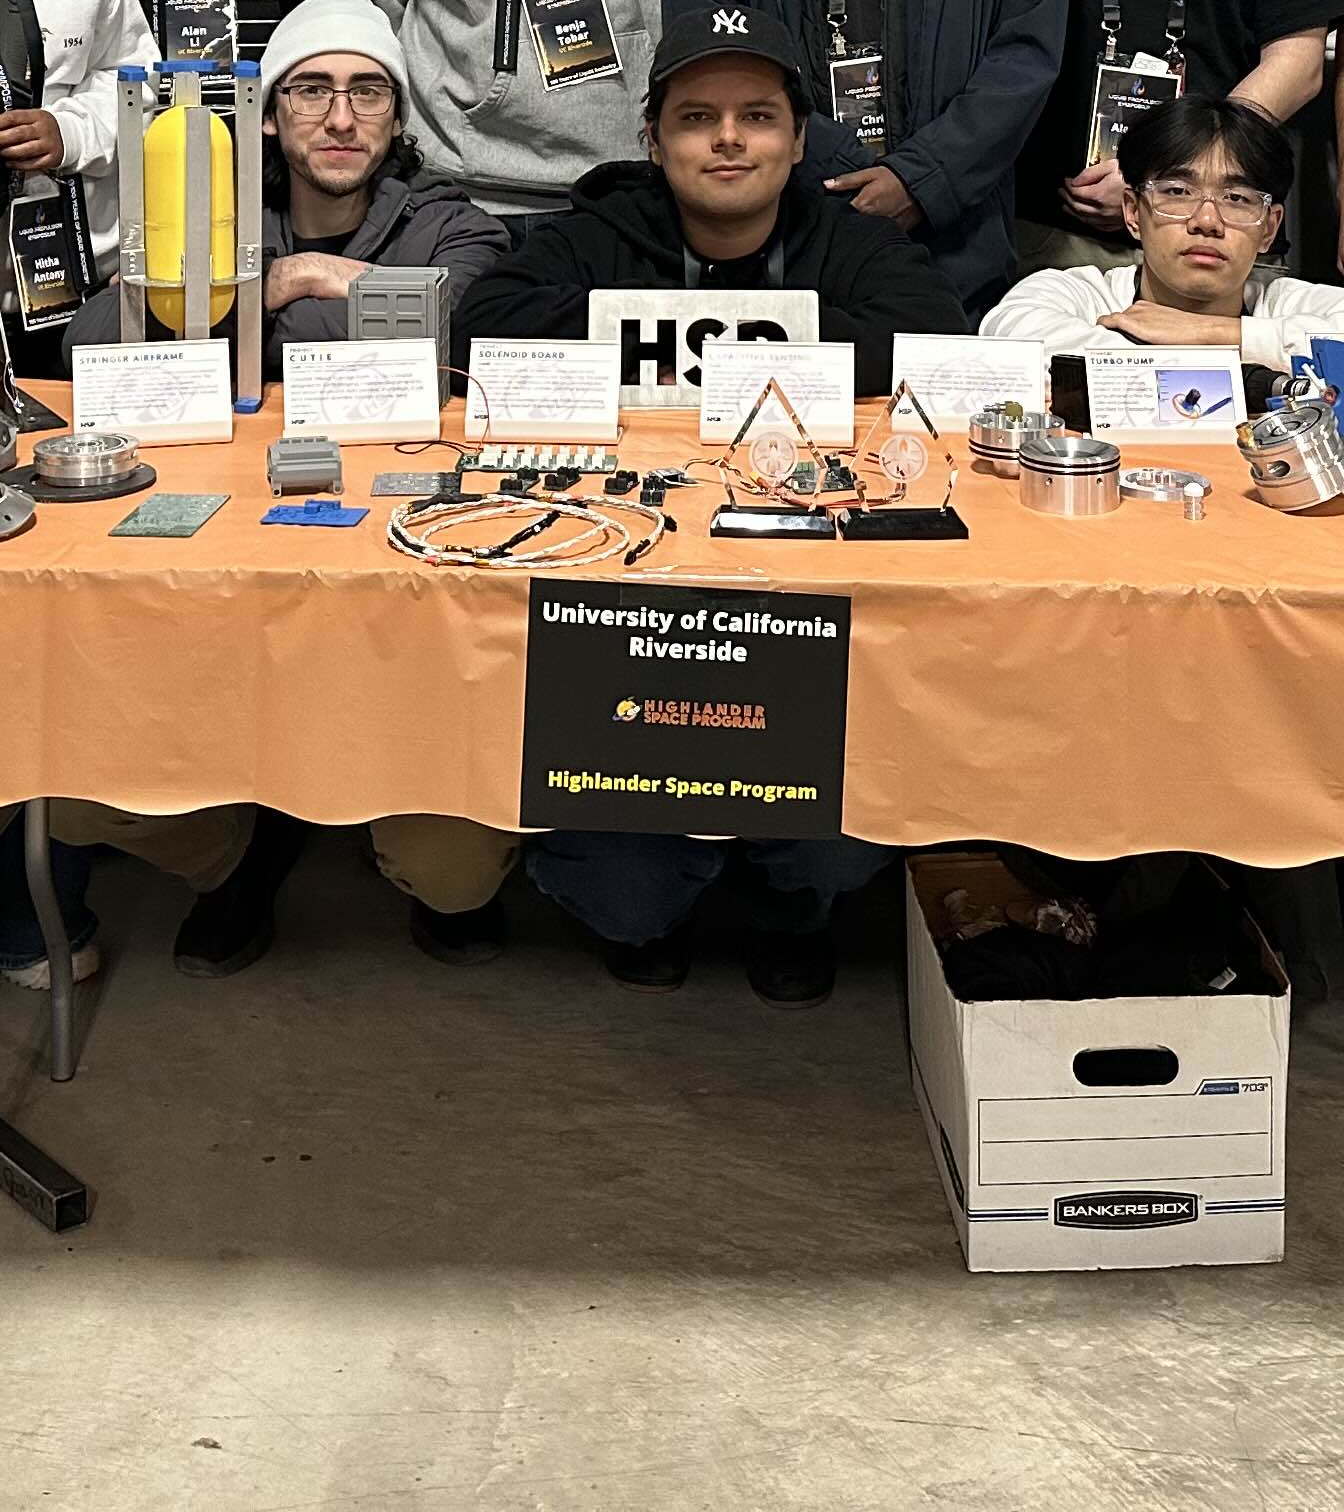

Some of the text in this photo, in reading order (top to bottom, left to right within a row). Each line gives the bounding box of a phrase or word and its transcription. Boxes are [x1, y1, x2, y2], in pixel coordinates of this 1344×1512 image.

[555, 19, 587, 35] Benja
[712, 8, 749, 34] NY
[181, 25, 207, 37] Alan
[63, 36, 84, 48] 1954
[557, 31, 590, 46] Tobar
[862, 114, 885, 125] Chri
[856, 128, 885, 137] Anto
[1110, 122, 1129, 134] Ale
[34, 256, 60, 270] Hitha
[33, 269, 66, 284] Antony
[80, 353, 184, 365] STRINGER AIRFRAME
[289, 353, 332, 362] CUTIE
[478, 350, 566, 360] SOLENOID BOARD
[1090, 357, 1155, 365] TURBO PUMP
[542, 601, 837, 639] University of California
[629, 637, 749, 663] Riverside
[644, 699, 766, 718] HIGHLANDER
[643, 712, 767, 730] SPACE PROGRAM
[547, 770, 818, 804] Highlander Space Program
[1062, 1201, 1191, 1218] BANKERS BOX
